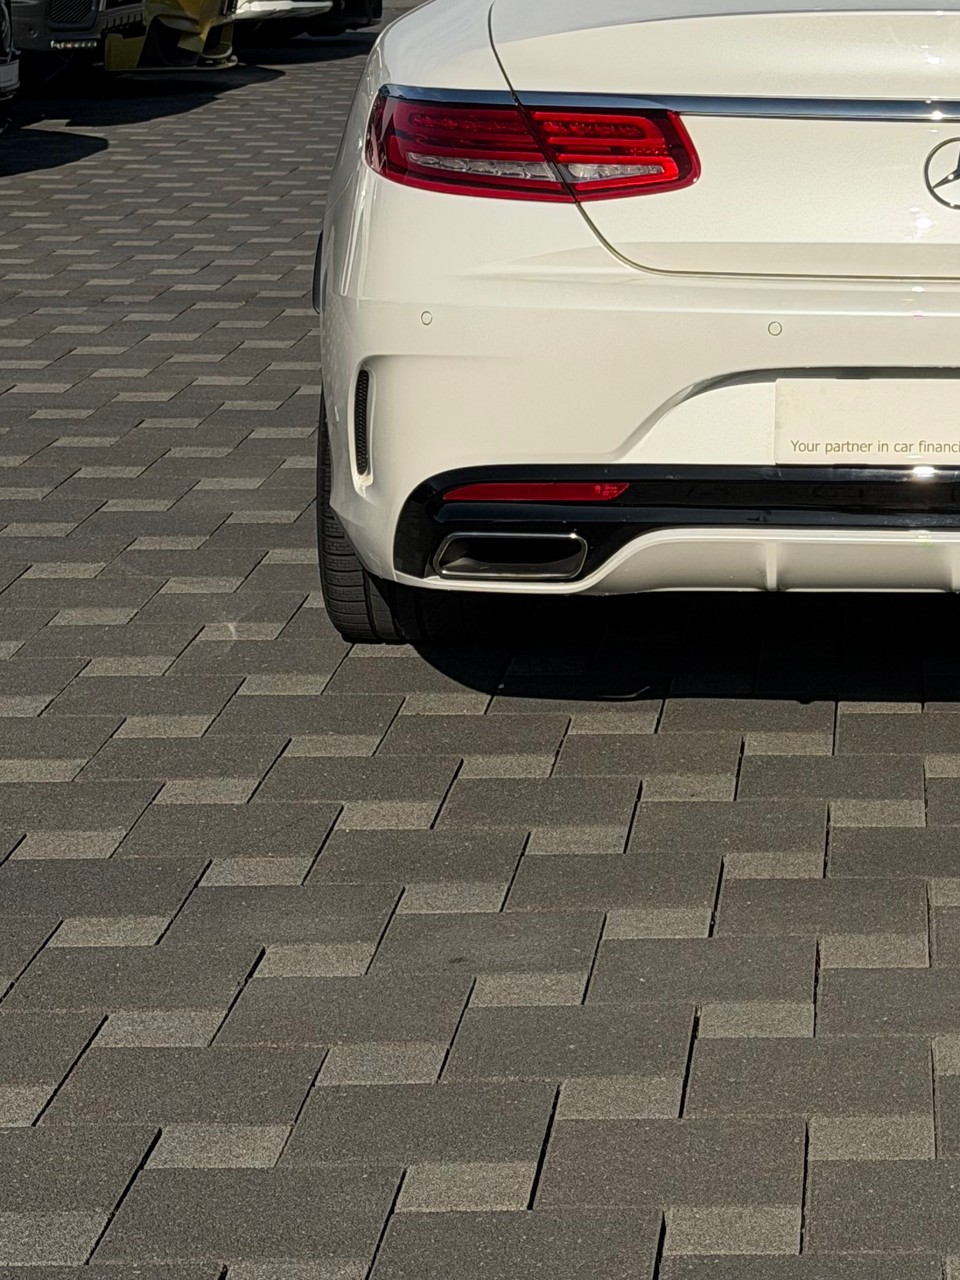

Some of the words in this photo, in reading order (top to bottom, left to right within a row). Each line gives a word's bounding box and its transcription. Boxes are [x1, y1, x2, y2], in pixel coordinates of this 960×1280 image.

[790, 440, 820, 453] Your
[824, 440, 873, 455] partner
[877, 440, 889, 453] in
[893, 442, 914, 453] car
